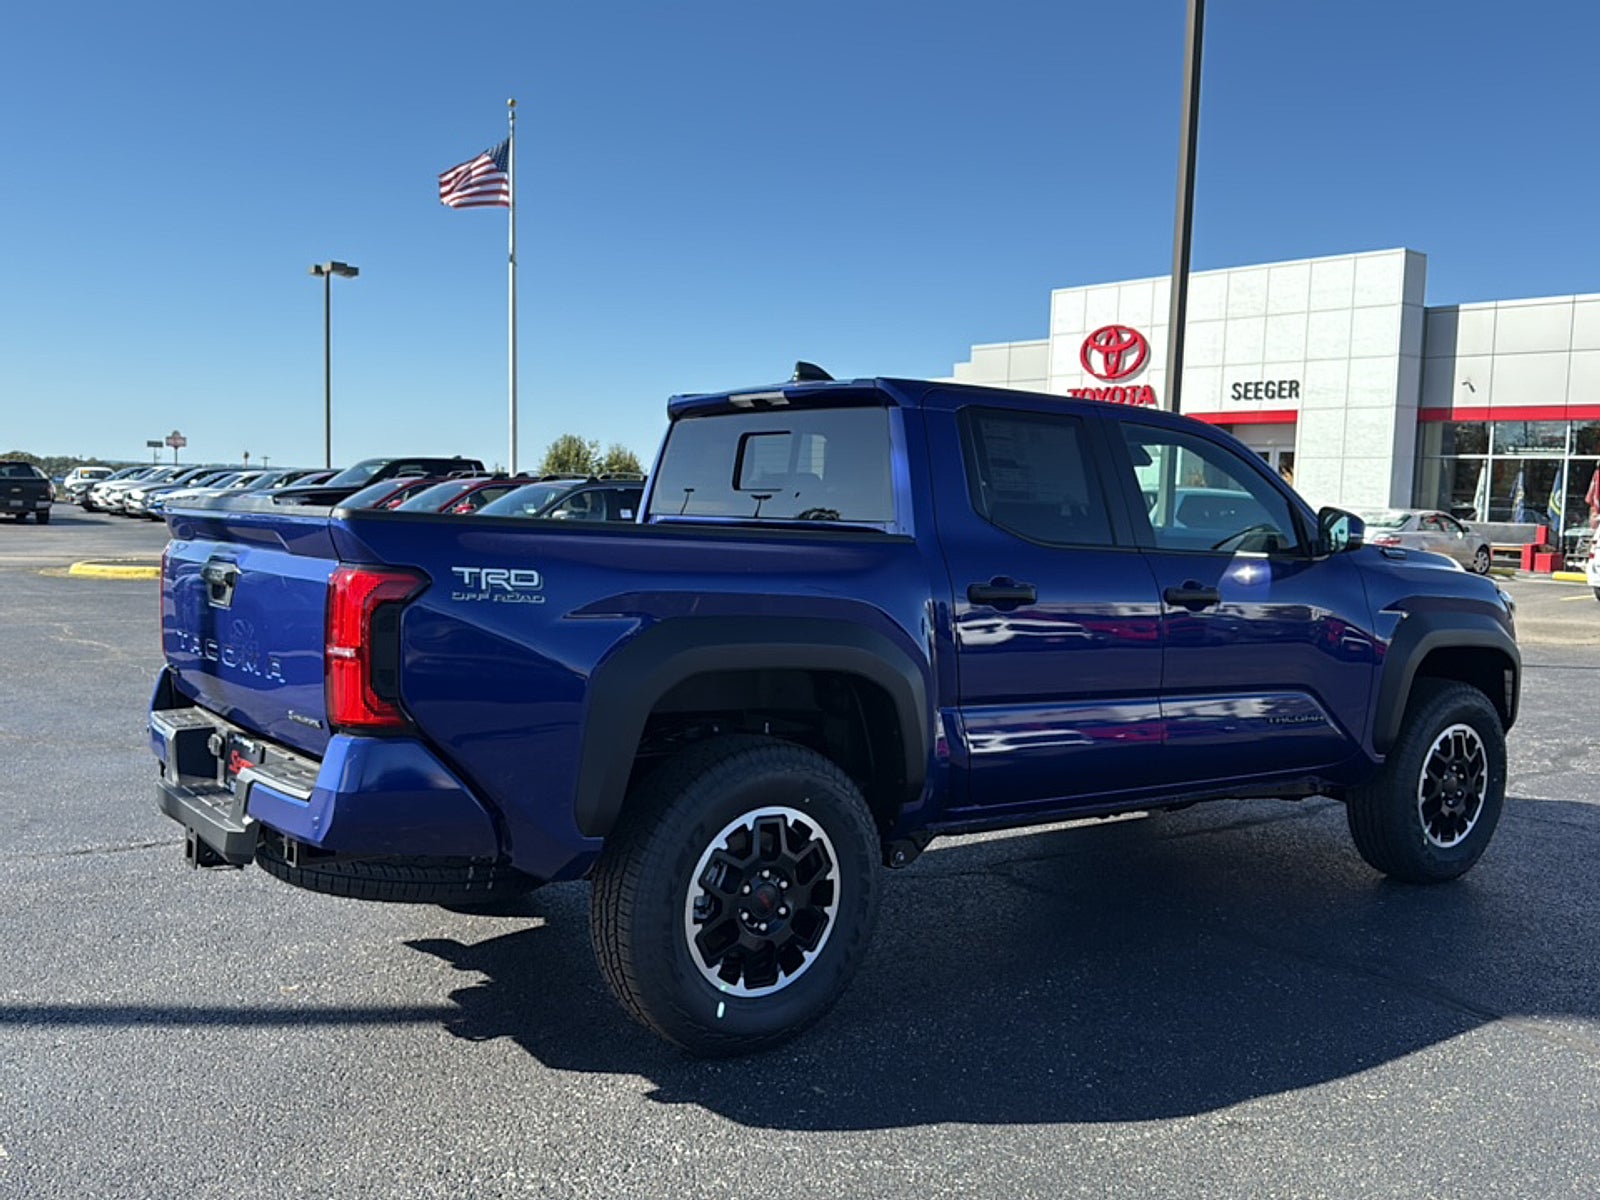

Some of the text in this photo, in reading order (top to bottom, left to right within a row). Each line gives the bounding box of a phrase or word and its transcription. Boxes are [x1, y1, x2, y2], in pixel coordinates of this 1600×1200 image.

[1067, 385, 1156, 406] TOYOTA
[1231, 380, 1300, 401] SEEGER
[452, 566, 539, 591] TRD
